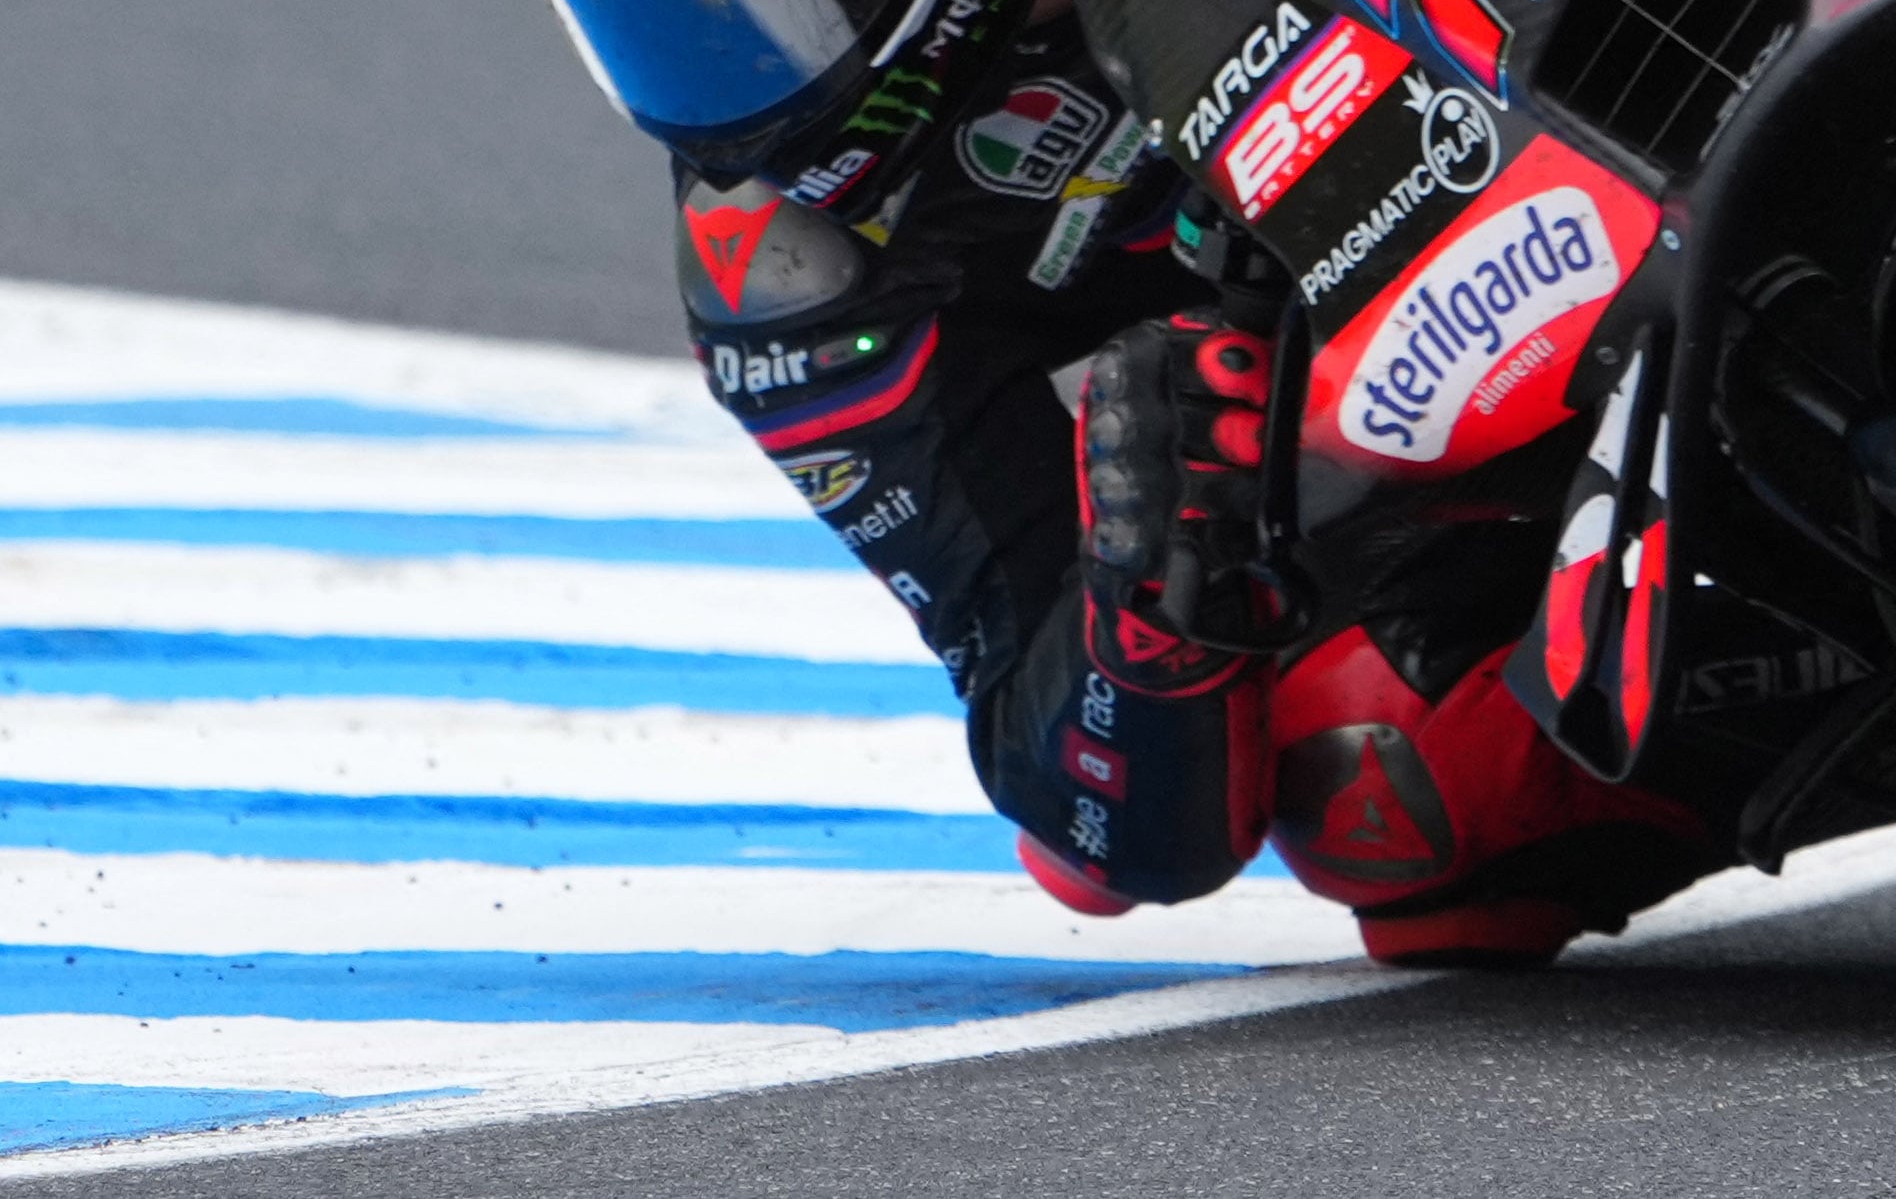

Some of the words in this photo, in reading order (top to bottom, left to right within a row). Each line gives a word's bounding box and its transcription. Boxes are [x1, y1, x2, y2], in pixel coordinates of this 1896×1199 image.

[1018, 104, 1091, 182] agv
[1178, 1, 1311, 161] TARGA
[1223, 31, 1366, 205] BS
[1300, 170, 1436, 306] PRAGMATIC
[1432, 111, 1489, 178] PLAY
[1363, 204, 1594, 448] sterilgarda
[1474, 332, 1556, 415] alimenti
